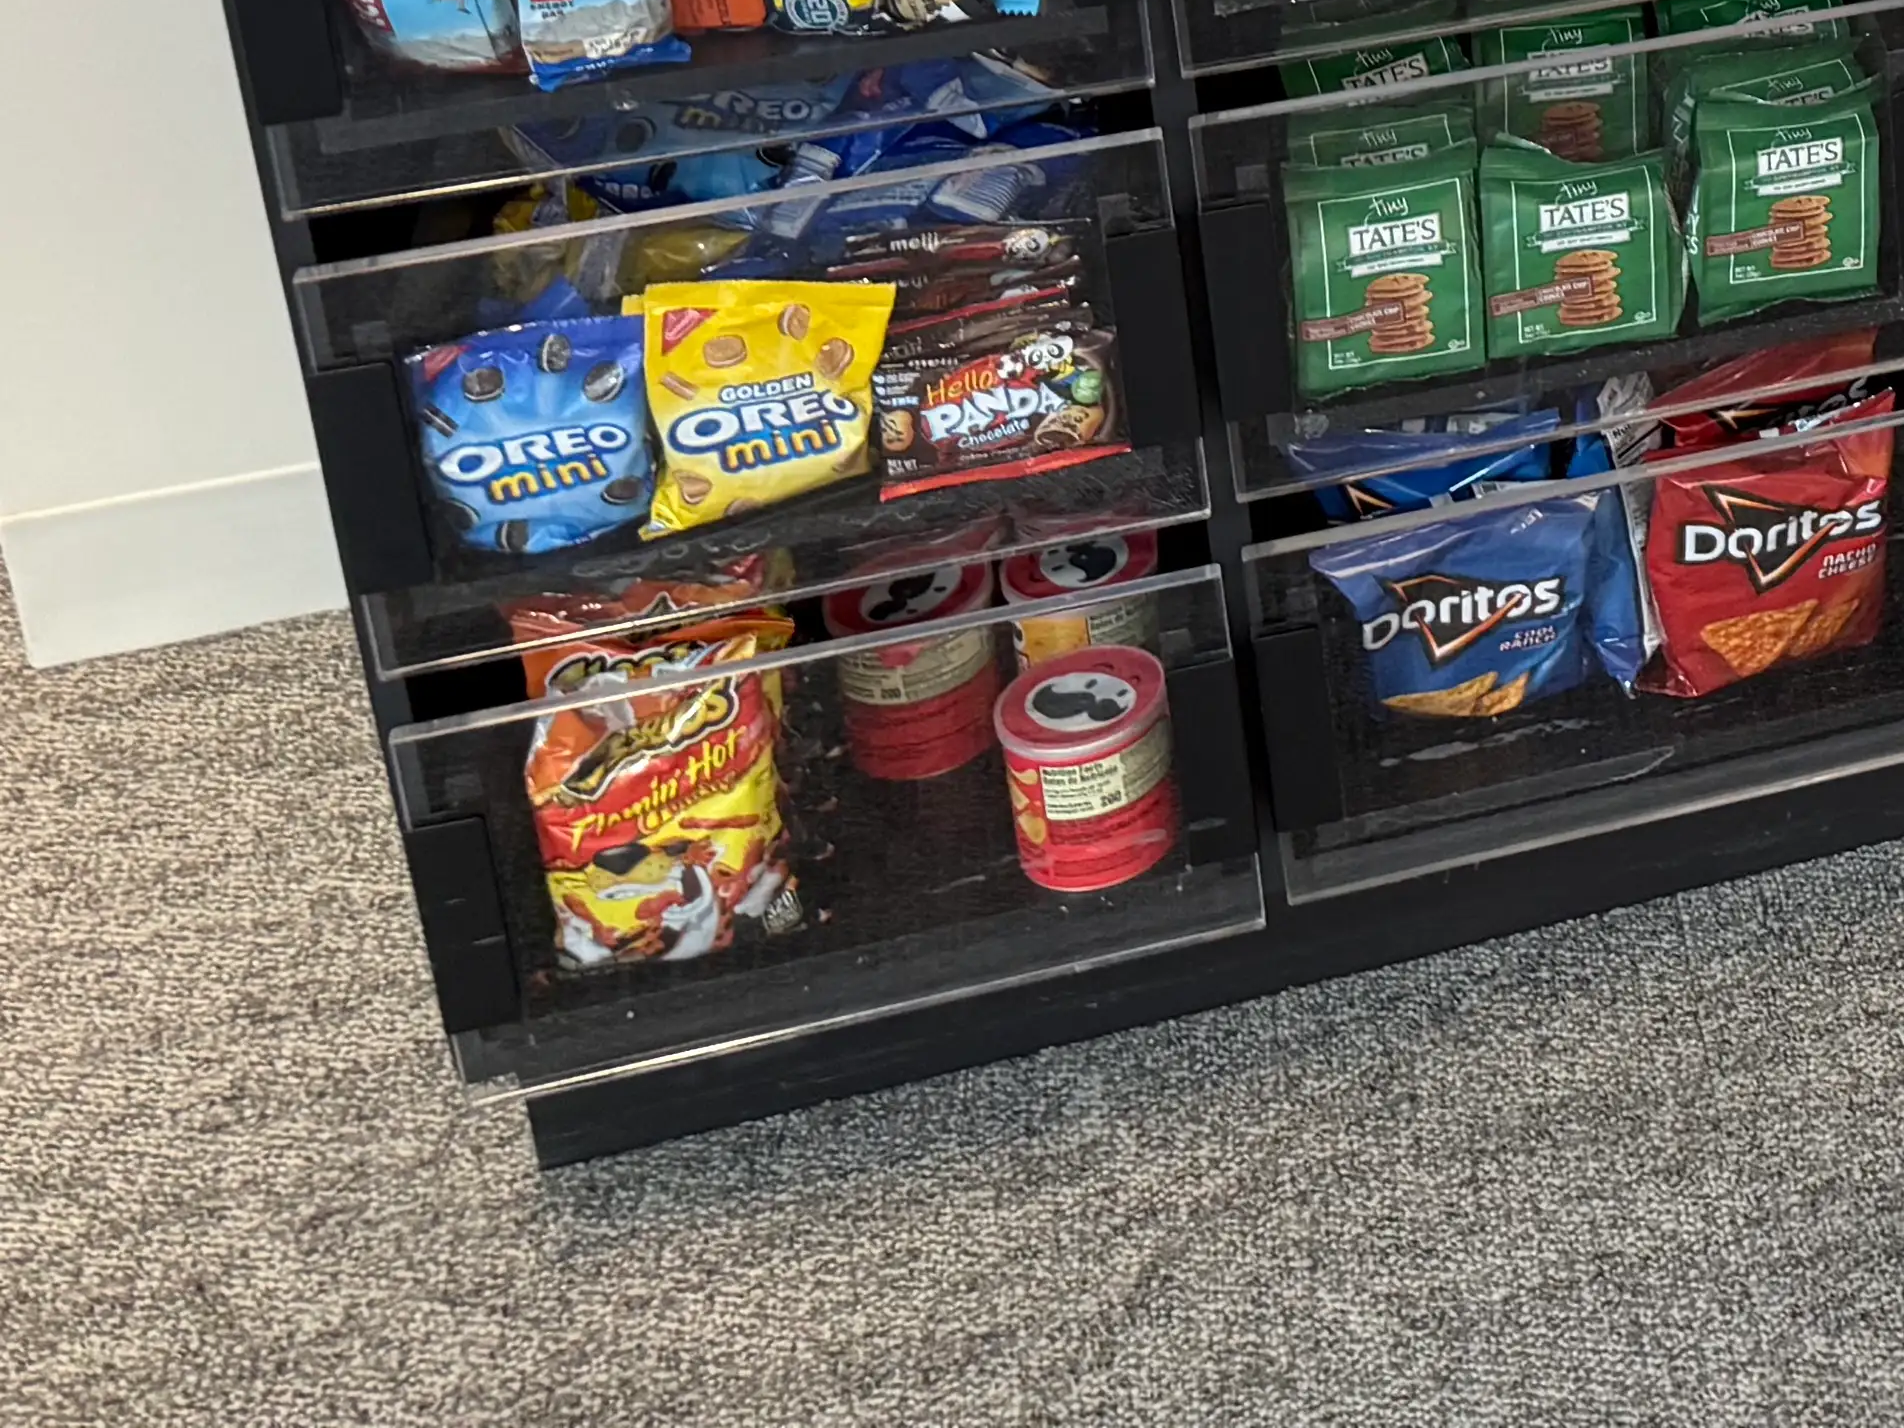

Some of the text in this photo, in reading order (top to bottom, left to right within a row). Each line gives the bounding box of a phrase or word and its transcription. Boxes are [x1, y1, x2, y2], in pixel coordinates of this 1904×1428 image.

[1774, 122, 1813, 142] tiny
[1760, 142, 1841, 174] TATE'S
[1559, 179, 1598, 198] tiny
[1370, 195, 1409, 217] tiny
[1543, 197, 1626, 229] TATE'S
[1352, 218, 1437, 252] TATE'S
[720, 373, 814, 405] GOLDEN
[927, 370, 993, 406] Hello
[669, 393, 856, 450] OREO
[920, 383, 1065, 442] PANDA
[725, 418, 841, 473] mini
[958, 419, 1030, 448] Chocolate
[436, 424, 630, 480] OREO
[489, 457, 608, 505] mini
[1684, 499, 1883, 564] Doritos
[1817, 559, 1877, 580] CHEESE
[1822, 545, 1876, 567] NACHO
[1362, 576, 1562, 652] Doritos
